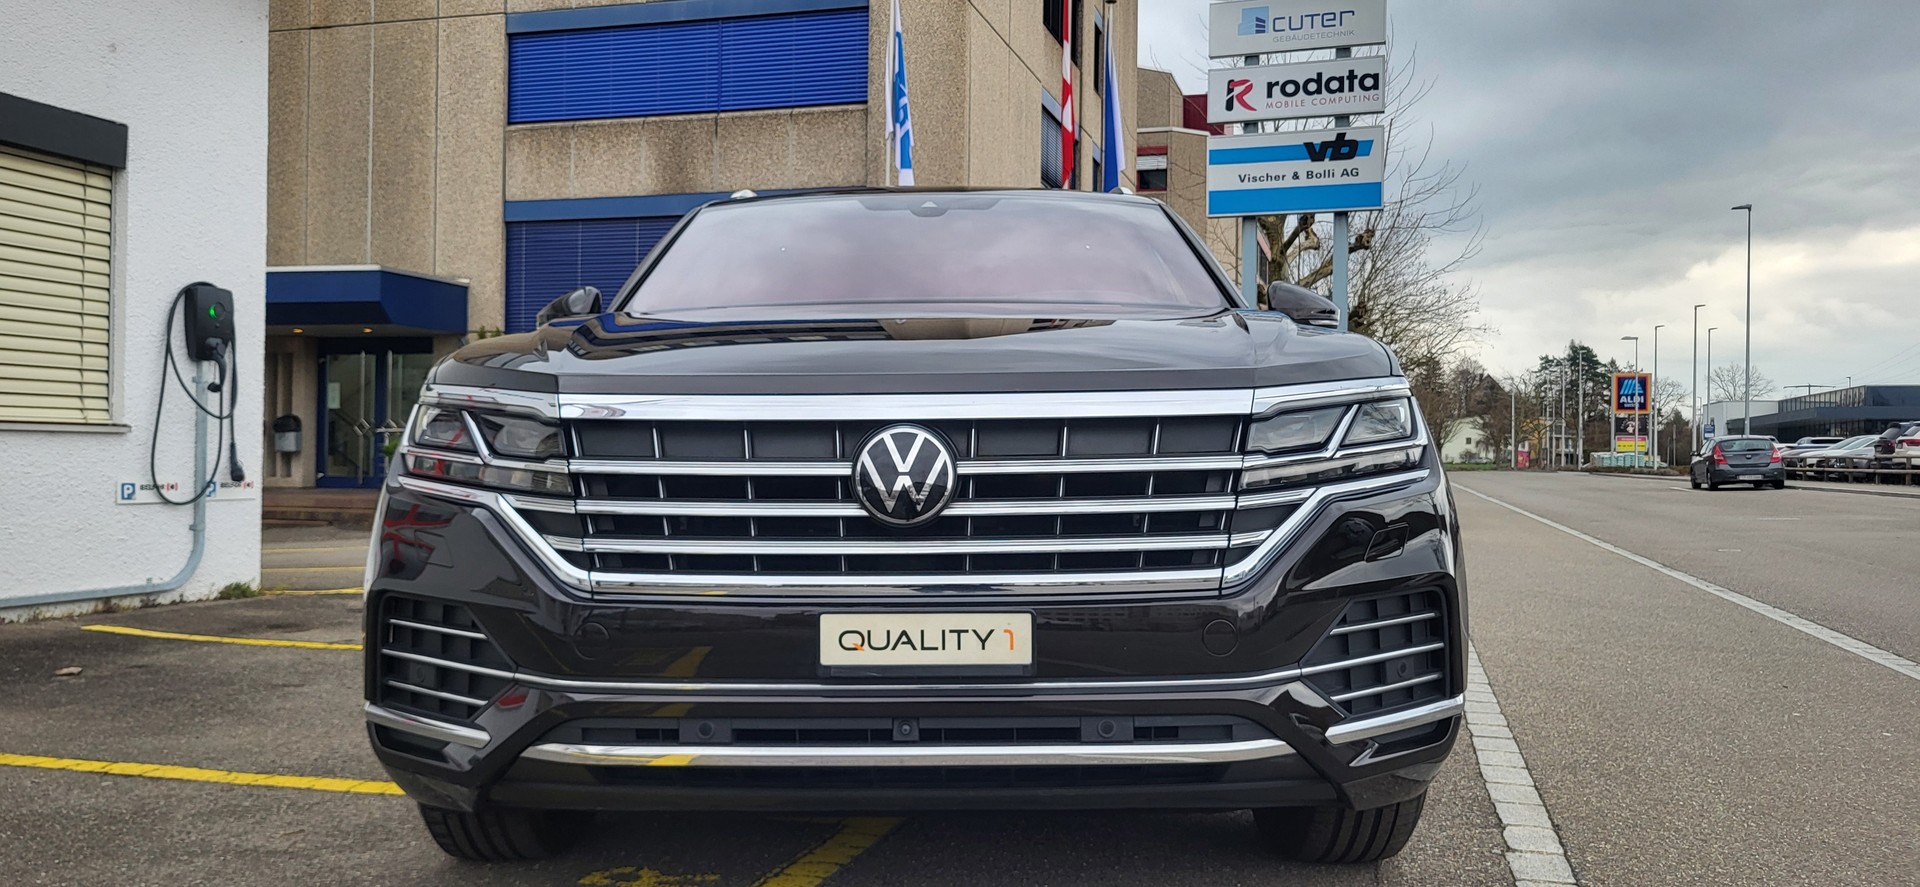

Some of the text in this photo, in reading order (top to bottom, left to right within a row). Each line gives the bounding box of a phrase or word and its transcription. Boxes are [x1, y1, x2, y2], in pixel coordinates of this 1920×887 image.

[1266, 69, 1380, 99] rodata
[1265, 94, 1380, 109] MOBILE COMPUTING
[1303, 132, 1359, 162] vb
[1238, 168, 1359, 183] Vischer & Bolli AG
[1619, 395, 1645, 403] ALDI
[838, 629, 1014, 651] QUALITY 1
